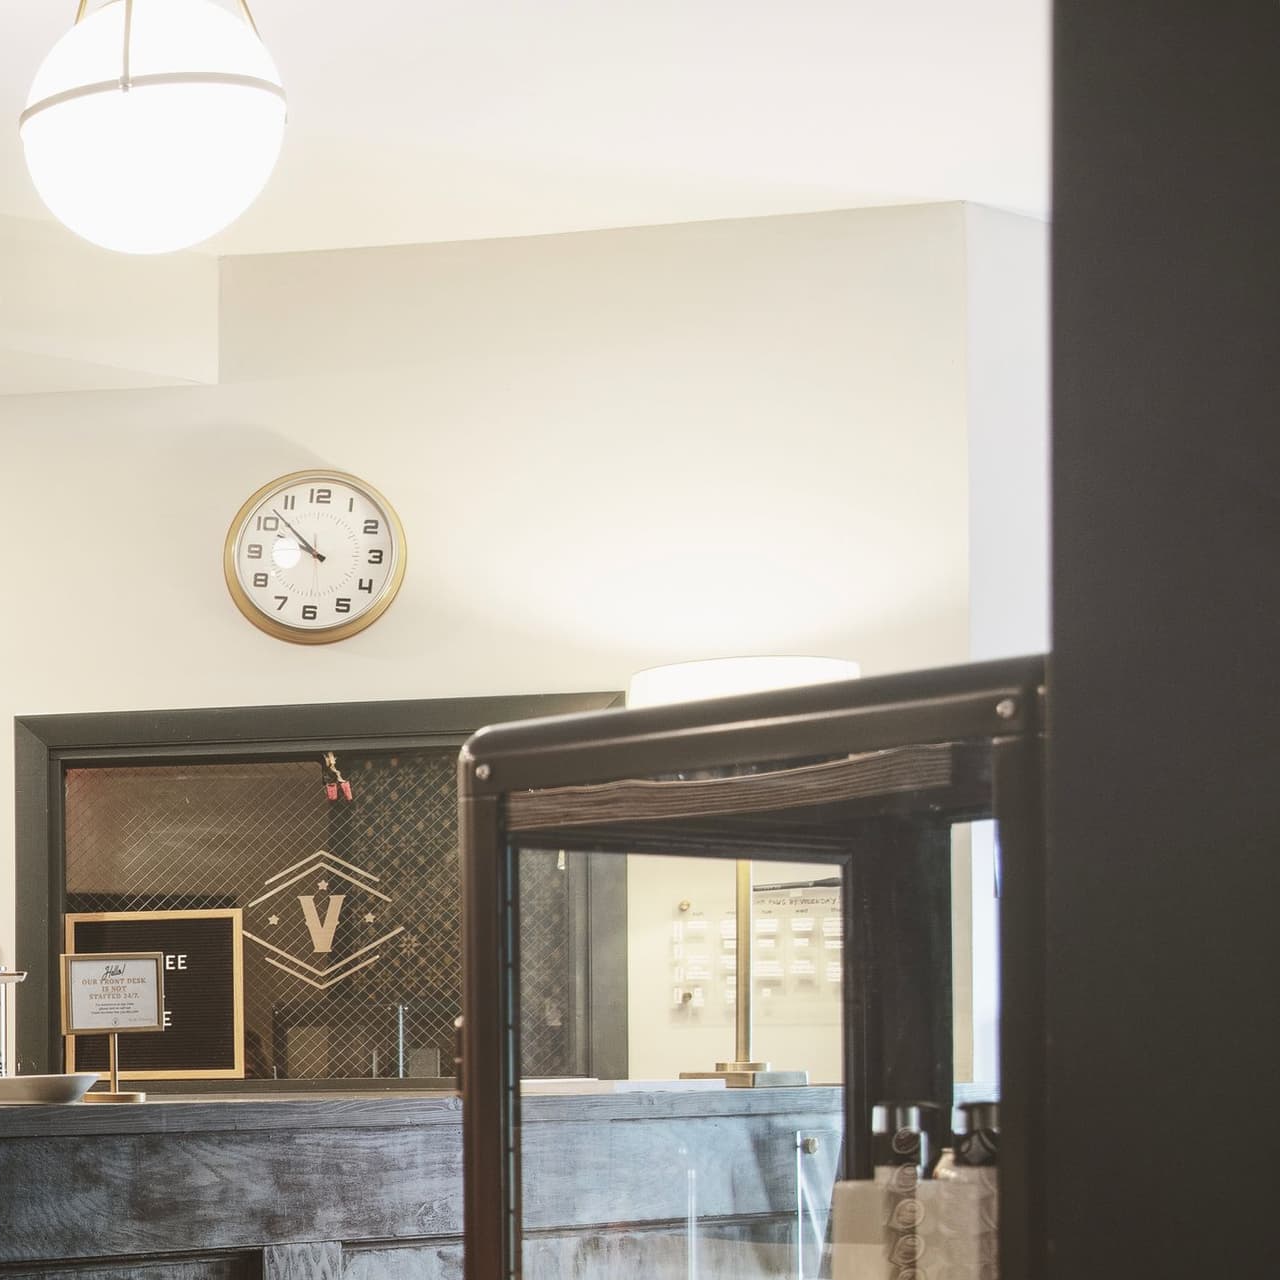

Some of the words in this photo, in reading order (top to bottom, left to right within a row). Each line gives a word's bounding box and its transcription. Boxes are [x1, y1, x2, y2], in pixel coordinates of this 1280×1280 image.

[283, 495, 295, 510] 11
[309, 488, 332, 504] 12
[348, 498, 354, 512] 1
[256, 516, 279, 531] 10
[363, 519, 379, 535] 2
[247, 544, 262, 559] 9
[367, 549, 383, 564] 3
[253, 573, 269, 588] 8
[358, 578, 373, 594] 4
[274, 596, 288, 611] 7
[335, 598, 351, 613] 5
[301, 605, 318, 620] 6
[297, 894, 346, 953] V
